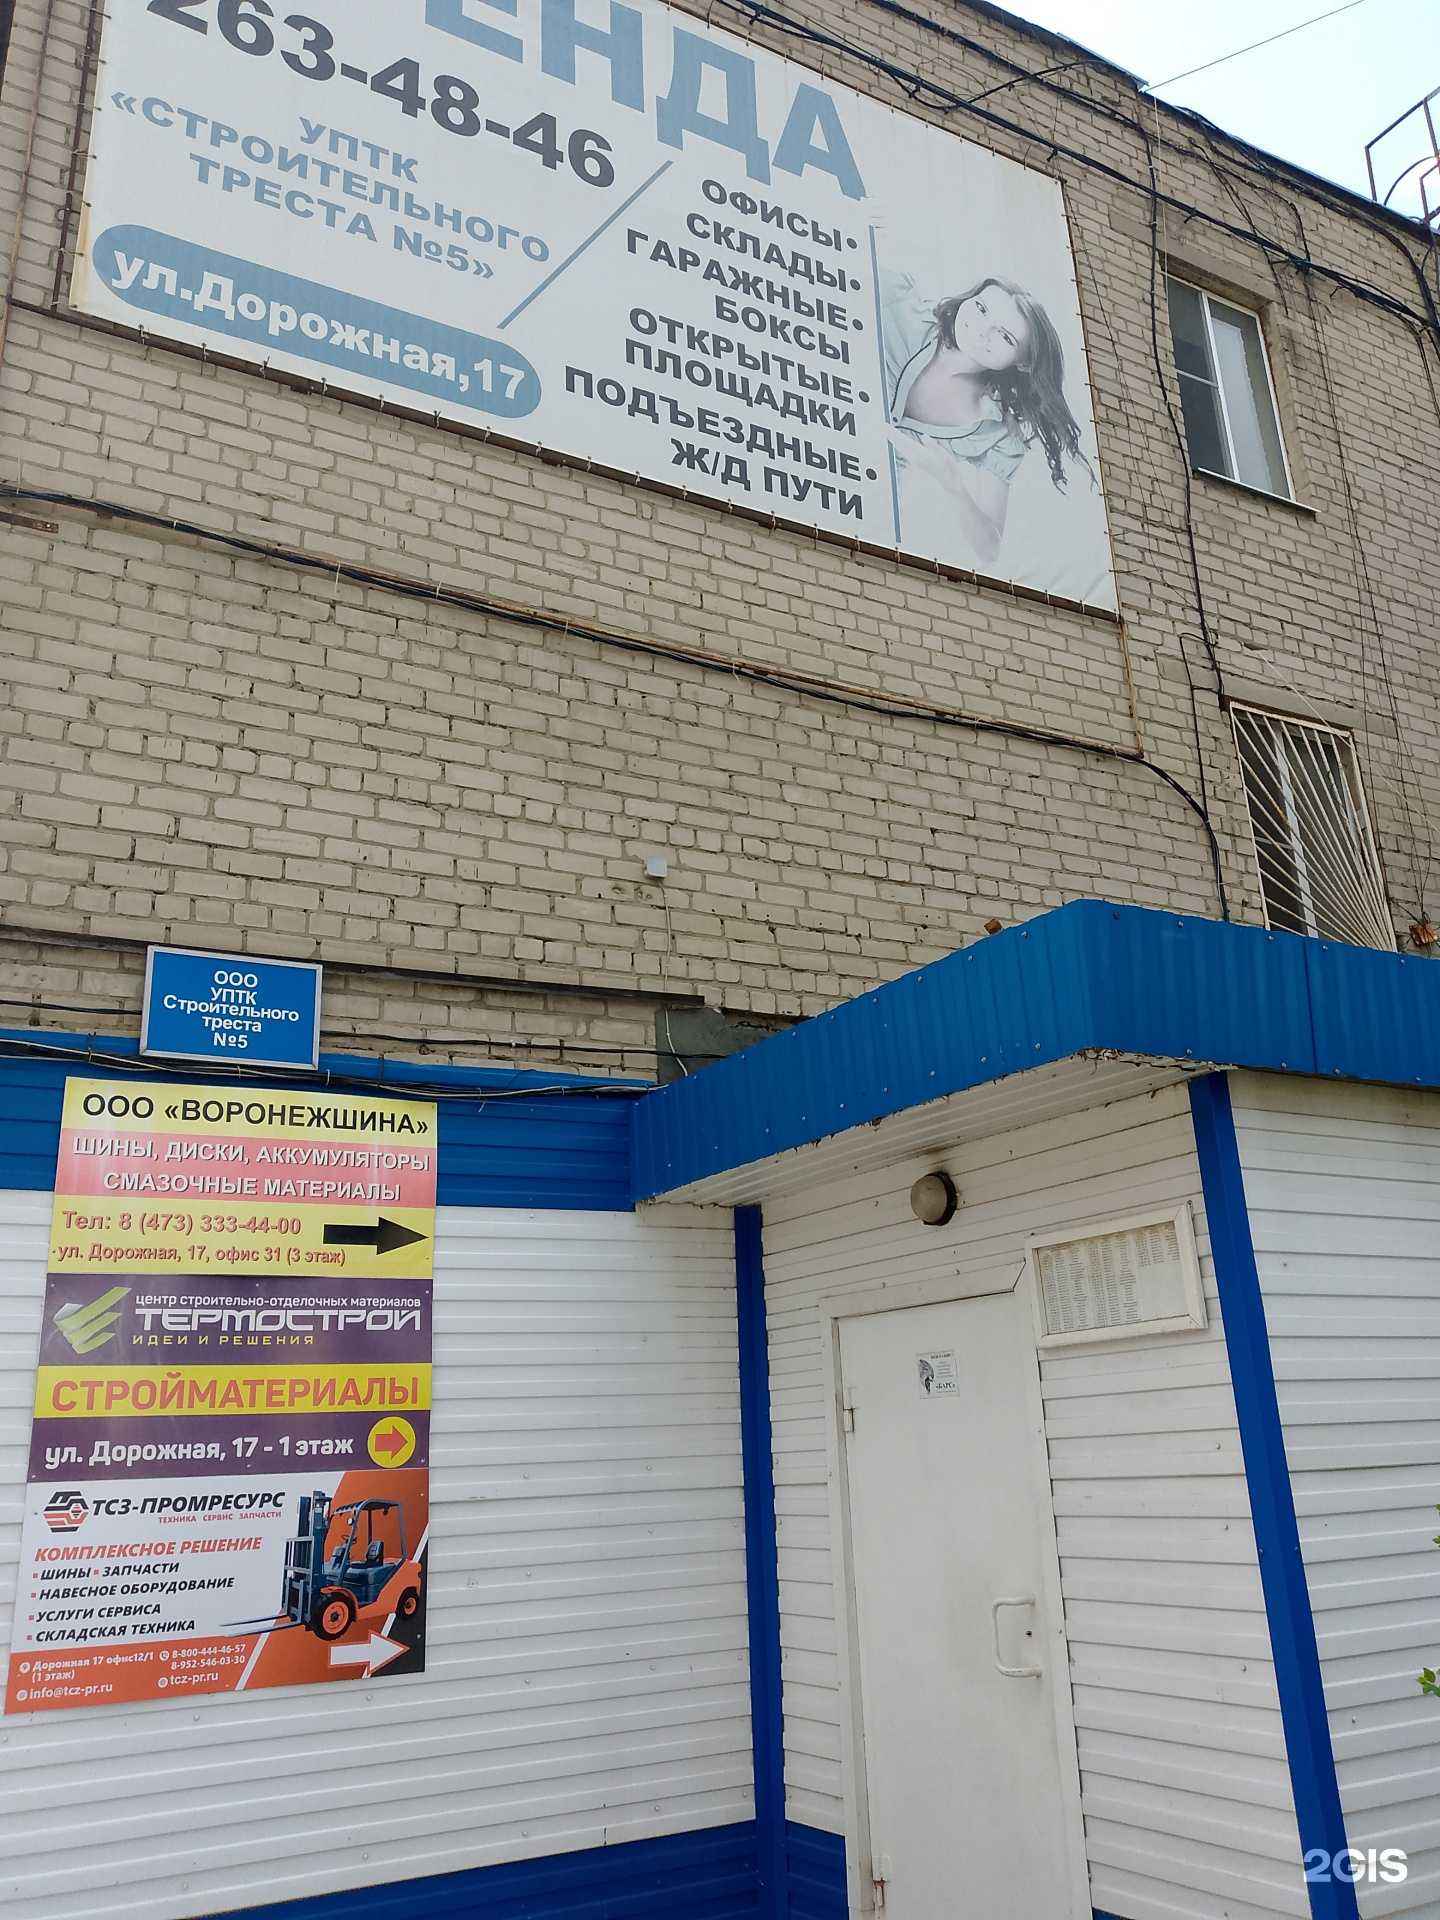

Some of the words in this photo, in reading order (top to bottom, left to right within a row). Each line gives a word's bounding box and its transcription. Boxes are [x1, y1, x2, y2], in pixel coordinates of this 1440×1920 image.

[299, 117, 419, 183] УПТК
[110, 90, 550, 263] «СТРОИТЕЛЬНОГО
[189, 153, 377, 242] ТРЕСТА
[393, 225, 494, 280] №5»
[701, 179, 842, 250] ОФИСЫ
[686, 213, 847, 292] СКЛАДЫ
[627, 228, 849, 330] ГАРАЖНЫЕ
[111, 249, 526, 400] ул.Дорожная,17
[715, 295, 850, 364] БОКСЫ
[629, 307, 853, 403] ОТКРЫТЫЕ
[625, 339, 856, 436] ПЛОЩАДКИ
[564, 366, 861, 482] ПОДЪЕЗДНЫЕ
[671, 438, 751, 492] Ж/Д
[764, 466, 863, 519] ПУТИ
[213, 970, 259, 988] ООО
[163, 994, 300, 1022] Строительного
[211, 987, 258, 1005] УПТК
[202, 1016, 262, 1033] треста
[213, 1032, 248, 1049] №5
[83, 1093, 155, 1119] ООО
[165, 1099, 429, 1135] «ВОРОНЕЖШИНА»
[72, 1136, 158, 1161] ШИНЫ,
[165, 1142, 249, 1165] ДИСКИ,
[256, 1148, 430, 1171] АККУМУЛЯТОРЫ
[103, 1172, 257, 1196] СМАЗОЧНЫЕ
[264, 1177, 400, 1200] МАТЕРИАЛЫ
[62, 1210, 111, 1230] Тел:
[119, 1212, 131, 1231] 8
[139, 1212, 193, 1235] (473)
[200, 1214, 302, 1235] 333-44-00
[57, 1246, 82, 1262] ул.
[88, 1244, 181, 1263] Дорожная,
[187, 1245, 210, 1263] 17,
[215, 1246, 259, 1263] офис
[265, 1248, 281, 1262] 31
[287, 1248, 300, 1266] (3
[305, 1250, 346, 1266] этаж)
[136, 1295, 176, 1308] центр
[180, 1296, 348, 1308] строительно-отделочных
[350, 1297, 421, 1309] материалов
[135, 1307, 421, 1331] ТЕРМОСТРОЙ
[133, 1335, 188, 1346] ИДЕИ
[199, 1335, 208, 1345] И
[219, 1335, 314, 1345] РЕШЕНИЯ
[52, 1372, 418, 1412] СТРОЙМАТЕРИАЛЫ
[45, 1446, 83, 1469] ул.
[89, 1441, 226, 1466] Дорожная,
[232, 1437, 257, 1457] 17
[279, 1437, 289, 1456] 1
[295, 1437, 353, 1457] этаж
[92, 1491, 285, 1516] ТСЗ-ПРОМРЕСУРС
[158, 1516, 197, 1524] ТЕХНИКА
[203, 1514, 233, 1522] СЕРВИС
[239, 1511, 282, 1520] ЗАПЧАСТИ
[34, 1541, 176, 1562] КОМПЛЕКСНОЕ
[180, 1537, 262, 1555] РЕШЕНИЕ
[40, 1567, 91, 1580] ШИНЫ
[102, 1563, 180, 1578] ЗАПЧАСТИ
[39, 1585, 117, 1600] НАВЕСНОЕ
[120, 1577, 235, 1595] ОБОРУДОВАНИЕ
[36, 1608, 94, 1622] УСЛУГИ
[97, 1604, 161, 1618] СЕРВИСА
[36, 1626, 127, 1643] СКЛАДСКАЯ
[131, 1620, 195, 1636] ТЕХНИКА
[32, 1658, 90, 1672] Дорожная
[93, 1656, 104, 1666] 17
[32, 1672, 42, 1683] (1
[44, 1670, 75, 1682] этаж)
[29, 1682, 113, 1700] info@tcz-pr.ru
[170, 1672, 219, 1687] tcz-pr.ru
